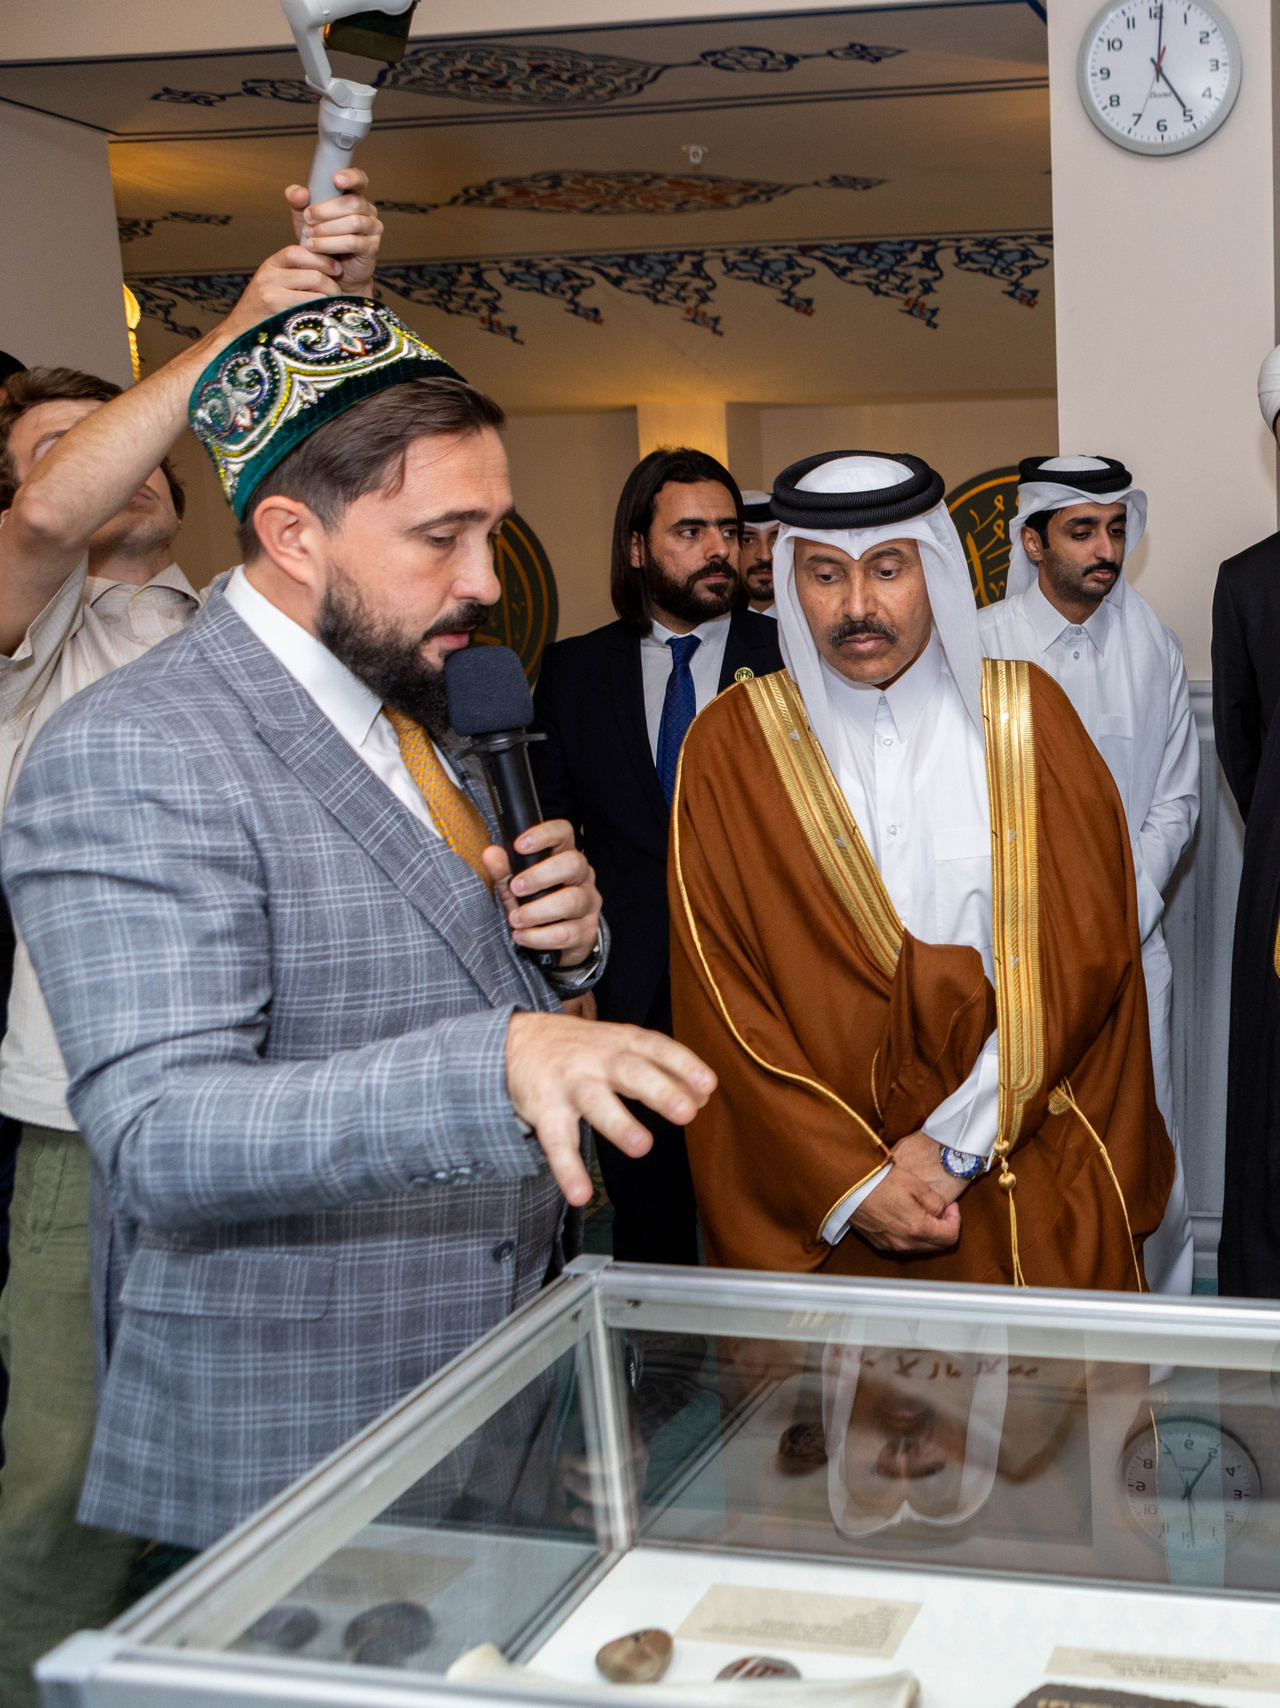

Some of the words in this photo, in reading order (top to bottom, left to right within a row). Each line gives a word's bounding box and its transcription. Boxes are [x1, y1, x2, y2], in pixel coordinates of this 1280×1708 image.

[1127, 17, 1135, 29] 11
[1199, 31, 1210, 44] 2
[1107, 38, 1122, 51] 10
[1210, 59, 1219, 72] 3
[1100, 67, 1110, 80] 9
[1202, 87, 1212, 99] 4
[1109, 94, 1120, 107] 8
[1132, 113, 1142, 126] 7
[1183, 109, 1193, 123] 5
[1157, 119, 1167, 132] 6
